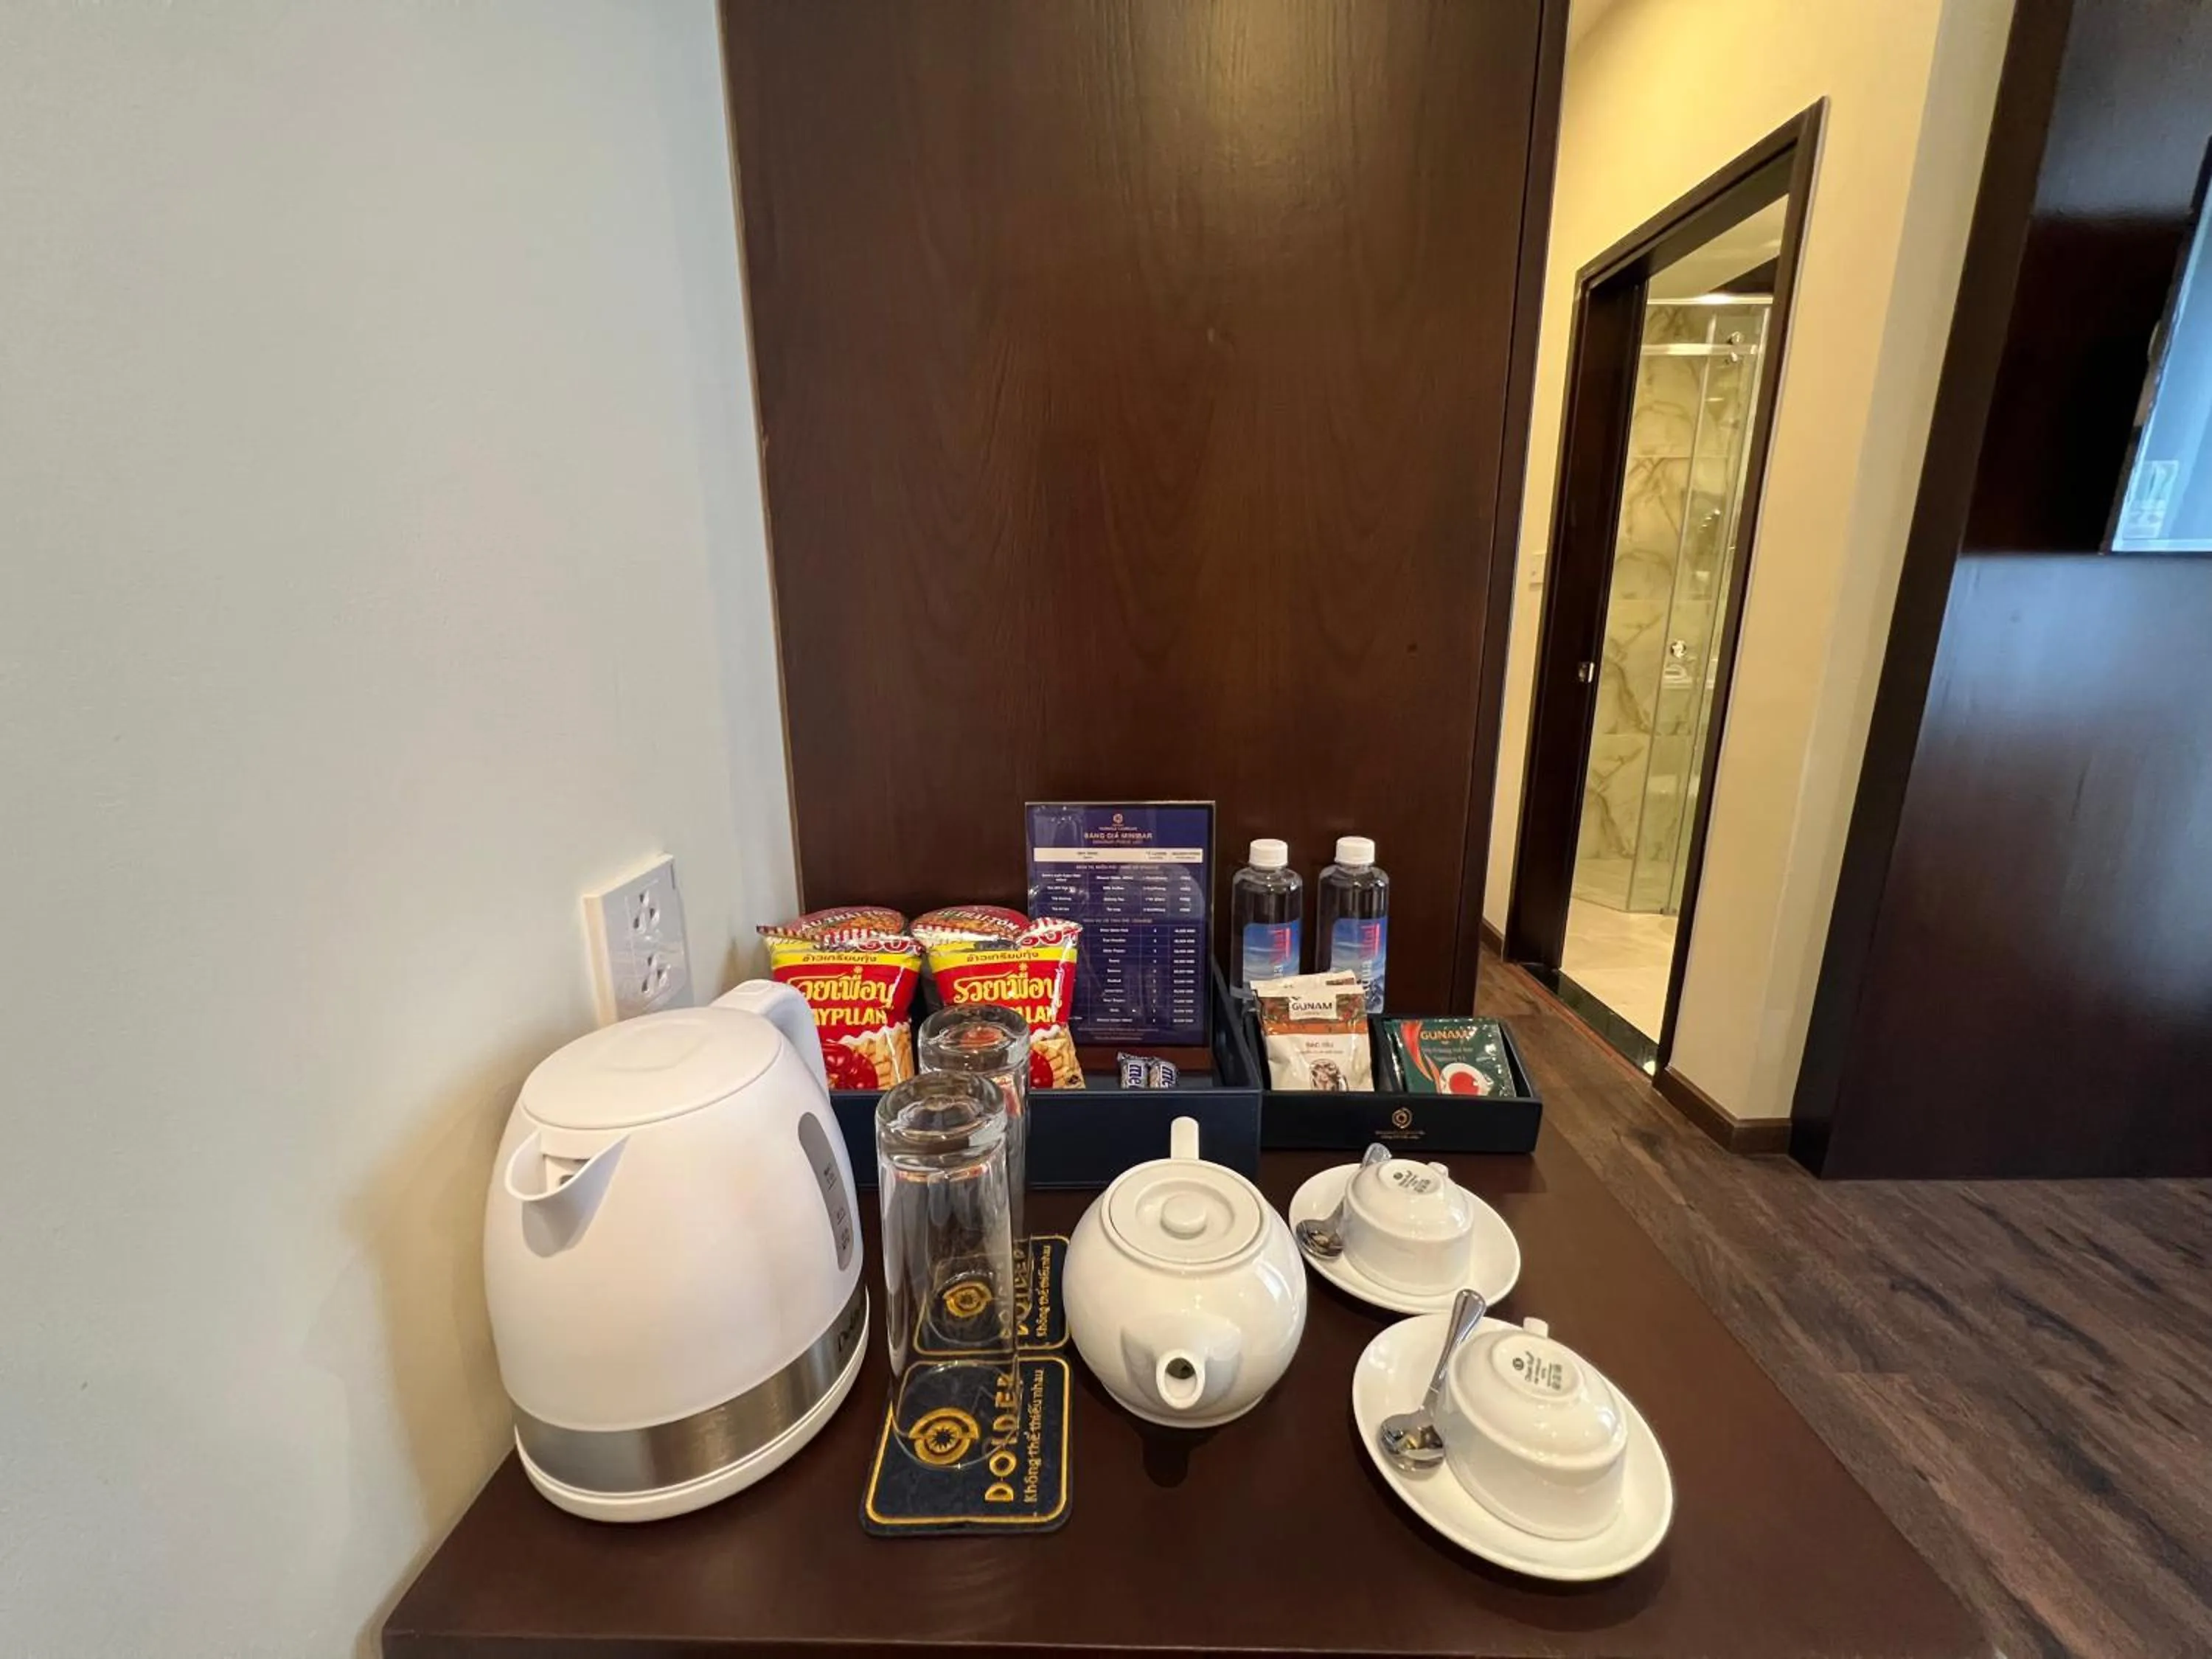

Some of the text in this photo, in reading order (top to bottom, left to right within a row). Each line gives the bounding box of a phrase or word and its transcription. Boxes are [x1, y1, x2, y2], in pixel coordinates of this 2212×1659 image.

[1292, 1002, 1332, 1011] GUNAM
[1420, 1029, 1470, 1040] GUNAM
[1031, 1368, 1045, 1401] nhau
[1023, 1458, 1042, 1503] Không
